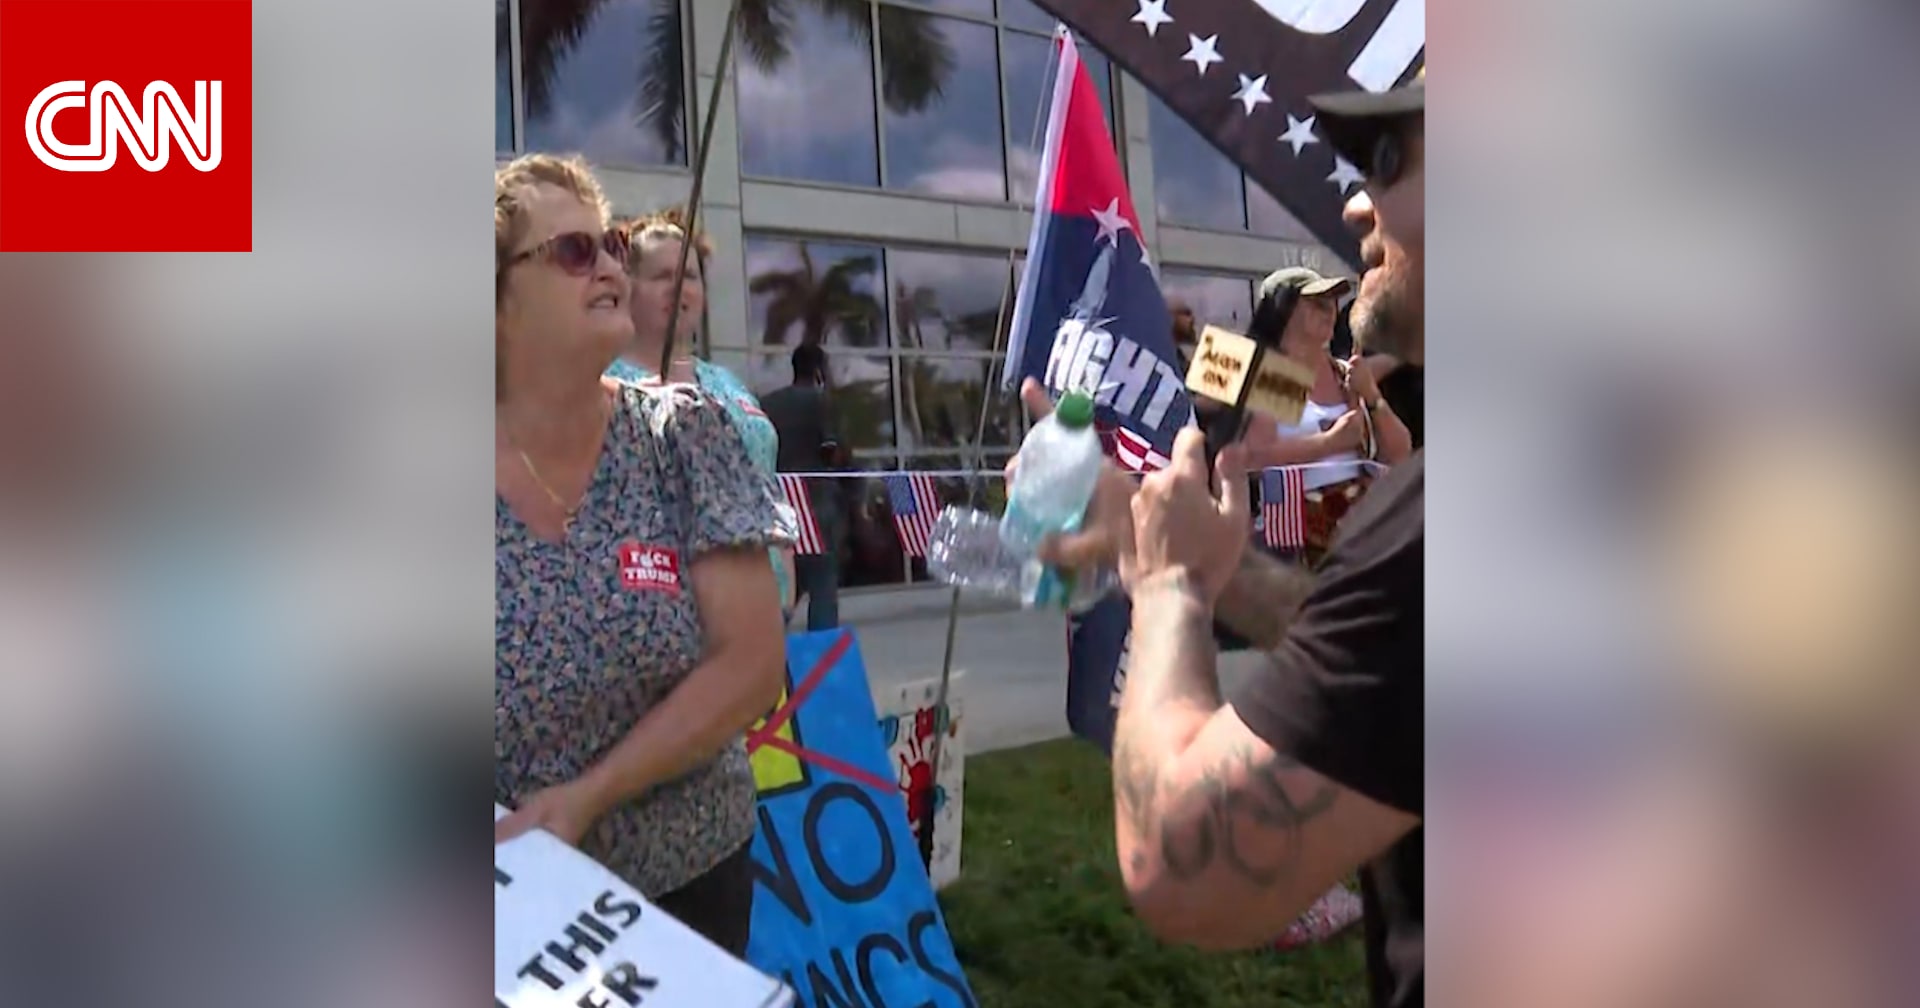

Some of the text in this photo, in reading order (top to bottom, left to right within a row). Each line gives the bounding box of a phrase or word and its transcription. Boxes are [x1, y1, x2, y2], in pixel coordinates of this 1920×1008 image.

[624, 567, 678, 585] TRUMP
[630, 550, 671, 567] FCK
[751, 782, 896, 927] NO
[517, 890, 642, 991] THIS
